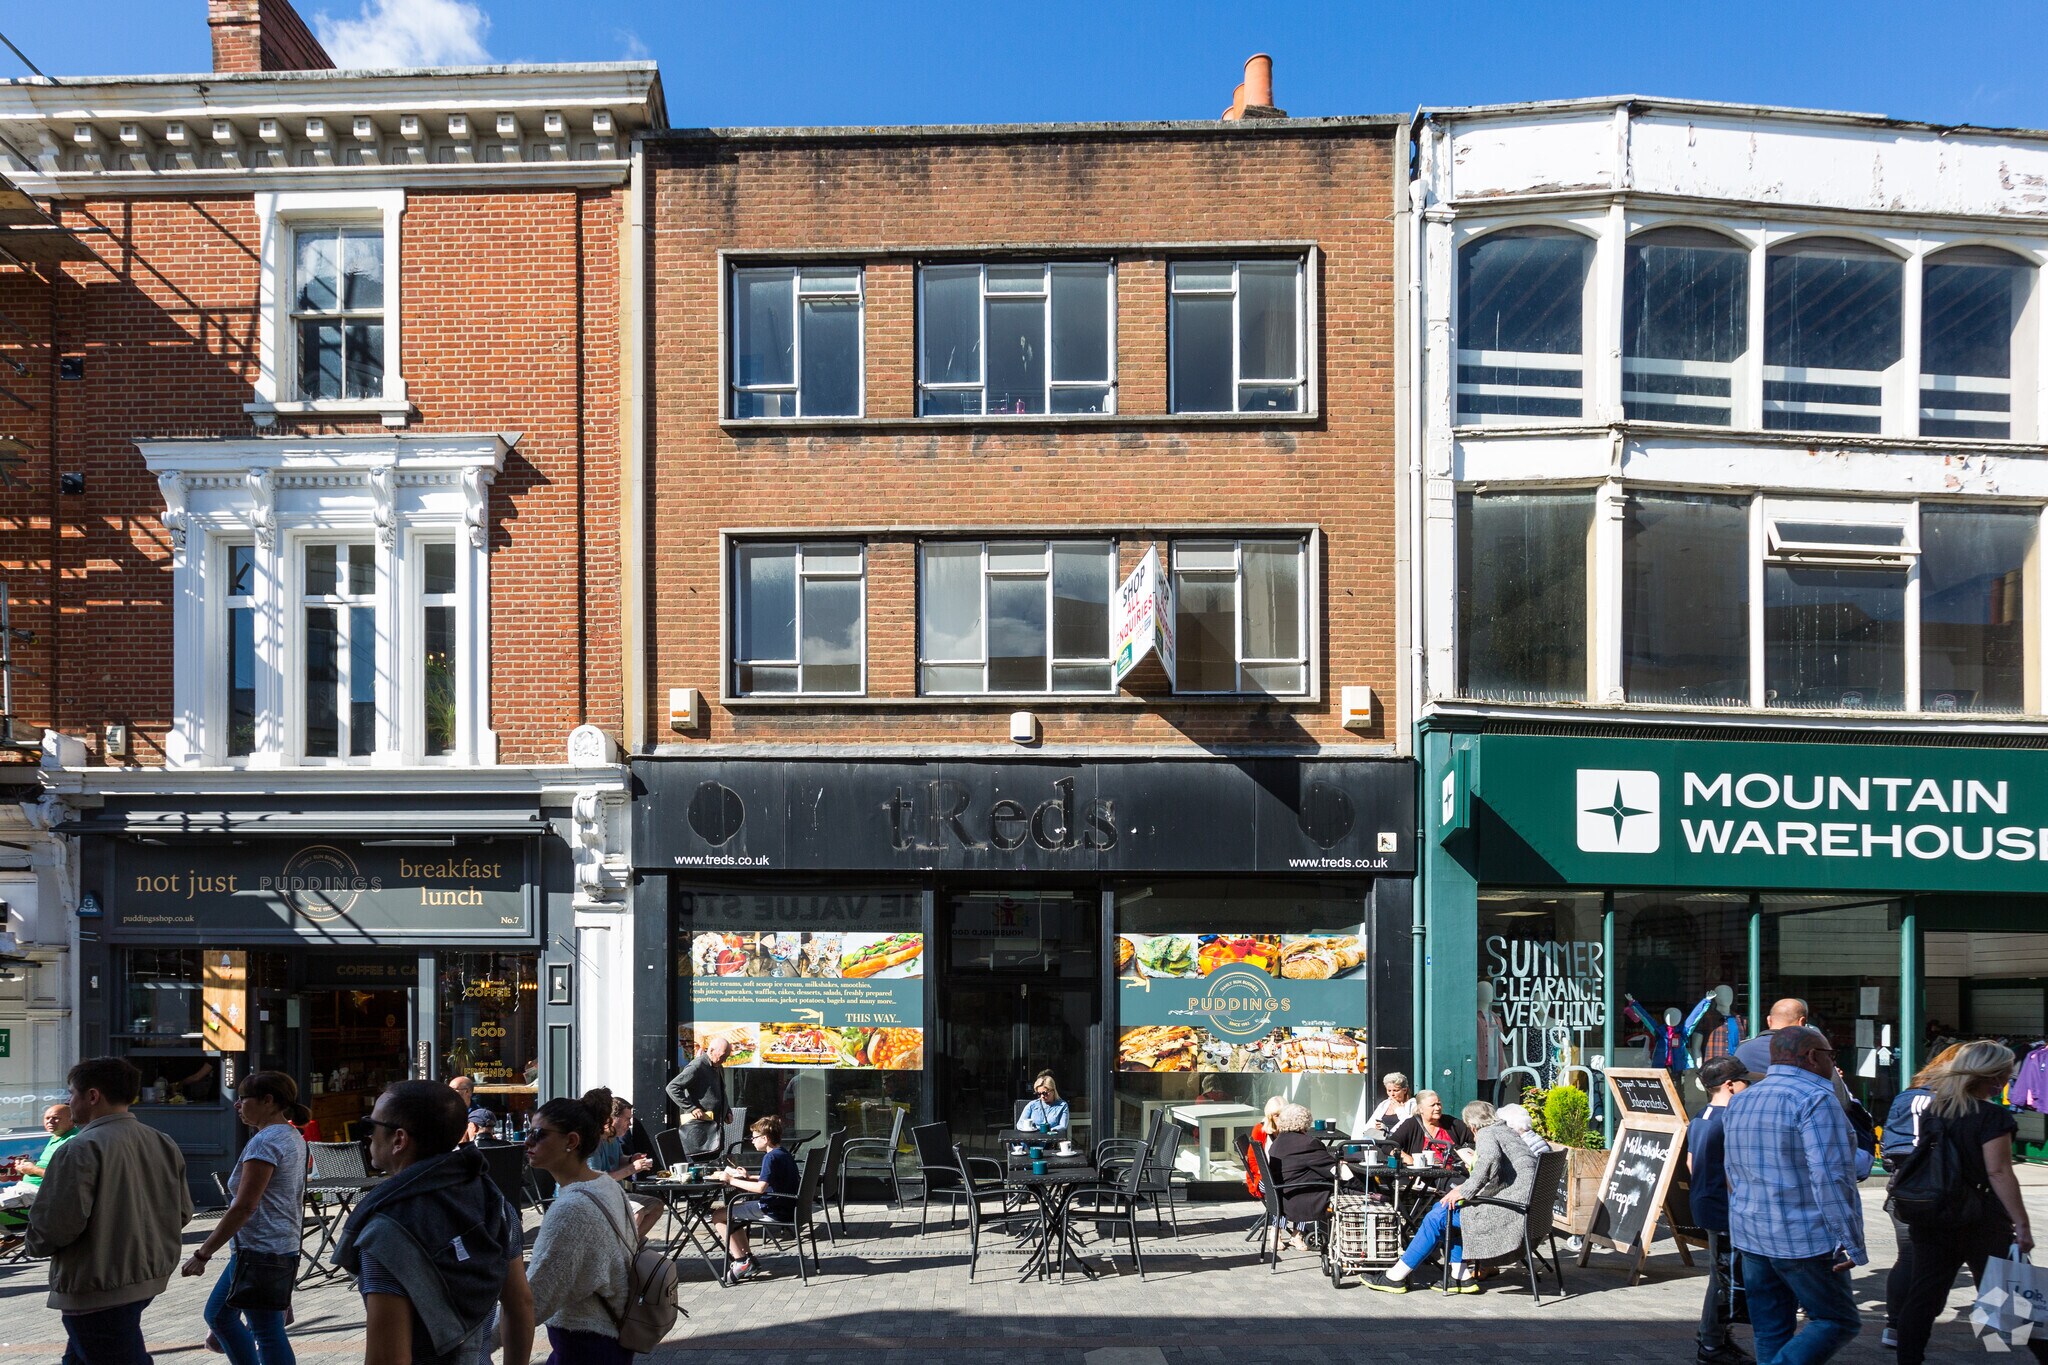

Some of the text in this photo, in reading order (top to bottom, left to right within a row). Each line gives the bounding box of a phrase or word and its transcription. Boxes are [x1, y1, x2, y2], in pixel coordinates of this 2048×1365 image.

[1123, 565, 1146, 608] SHOP
[1127, 593, 1140, 617] ALL
[1116, 594, 1153, 647] ENQUIRIES
[1683, 771, 2008, 814] MOUNTAIN
[882, 775, 1119, 851] tReds
[1680, 818, 2048, 862] WAREHOUS
[400, 858, 502, 879] breakfast
[674, 855, 770, 865] www.treds.co.uk
[1289, 857, 1388, 868] www.treds.co.uk
[136, 869, 239, 899] not just
[259, 876, 382, 893] PUDDINGS
[420, 885, 484, 906] lunch
[123, 914, 195, 924] puddingsshop.co.uk
[501, 916, 520, 924] No.7
[1486, 935, 1604, 978] SUMMER
[336, 965, 385, 976] COFFEE
[465, 987, 511, 998] COFFEE
[705, 988, 724, 996] juices,
[725, 988, 754, 997] pancakes,
[755, 988, 777, 996] waffles,
[796, 989, 822, 997] desserts,
[823, 989, 843, 997] salads,
[844, 989, 864, 997] freshly
[865, 990, 893, 998] prepared
[756, 981, 773, 990] scoop
[774, 980, 783, 988] ice
[784, 981, 804, 989] cream,
[805, 981, 839, 989] milkshakes,
[840, 981, 872, 989] smoothies,
[1493, 977, 1602, 1001] CLEARANCE
[719, 996, 755, 1004] sandwiches,
[780, 997, 798, 1005] jacket
[799, 997, 826, 1005] potatoes,
[827, 997, 845, 1005] bagels
[859, 998, 875, 1006] many
[1188, 997, 1291, 1011] PUDDINGS
[845, 1013, 902, 1024] THIS WAY...
[1489, 1001, 1605, 1027] EVERYTHING
[471, 1027, 507, 1038] FOOD
[1494, 1026, 1592, 1067] MUST
[463, 1067, 513, 1078] FRIENDS
[474, 1060, 489, 1068] enjoy
[1617, 1079, 1661, 1091] Support Your Local
[1627, 1092, 1669, 1113] Independents
[1623, 1136, 1671, 1162] Milkshakes
